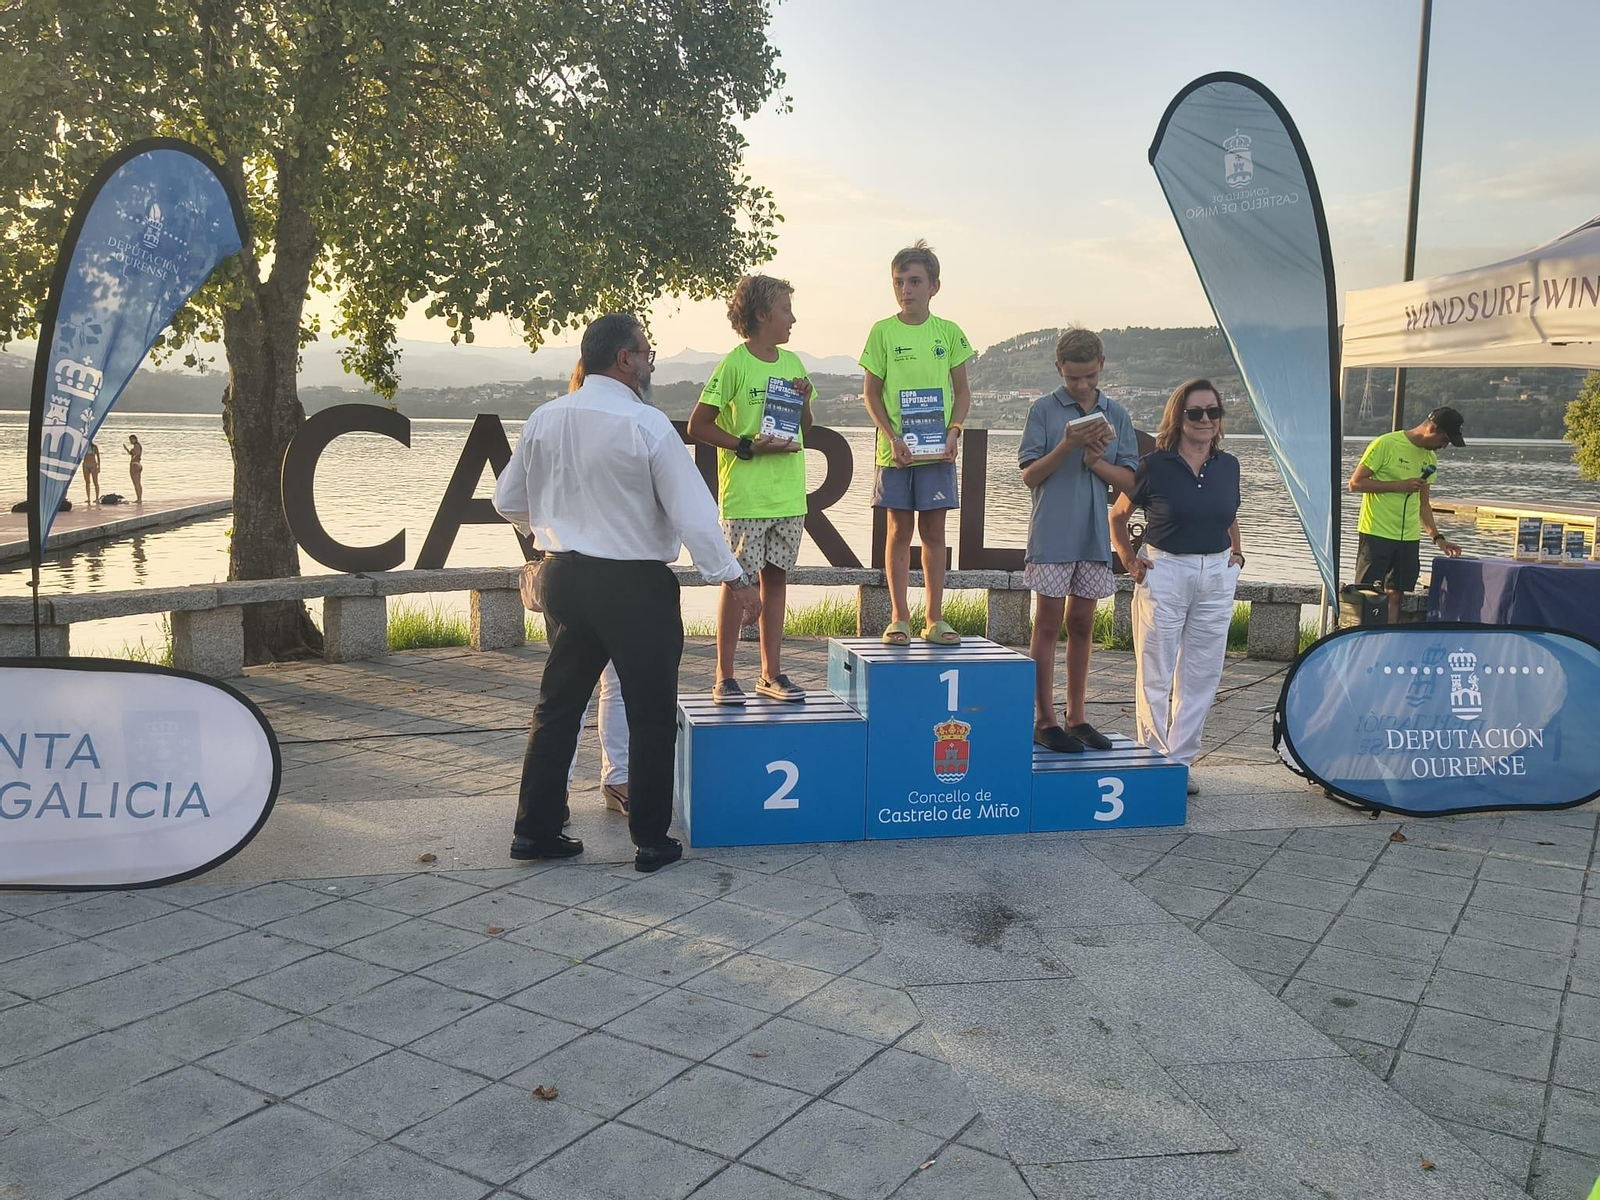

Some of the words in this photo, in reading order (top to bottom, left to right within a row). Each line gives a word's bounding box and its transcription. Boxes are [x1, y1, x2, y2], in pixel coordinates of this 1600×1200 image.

[115, 252, 169, 281] OURENSE
[939, 669, 960, 711] 1
[1386, 722, 1545, 751] DEPUTACIÓN
[1411, 755, 1527, 778] OURENSE
[763, 760, 800, 810] 2
[907, 789, 971, 804] Concello
[974, 789, 992, 802] de
[1093, 777, 1125, 822] 3
[0, 781, 212, 819] GALICIA
[877, 806, 949, 824] Castrelo
[951, 804, 972, 821] de
[976, 802, 1020, 820] Miño
